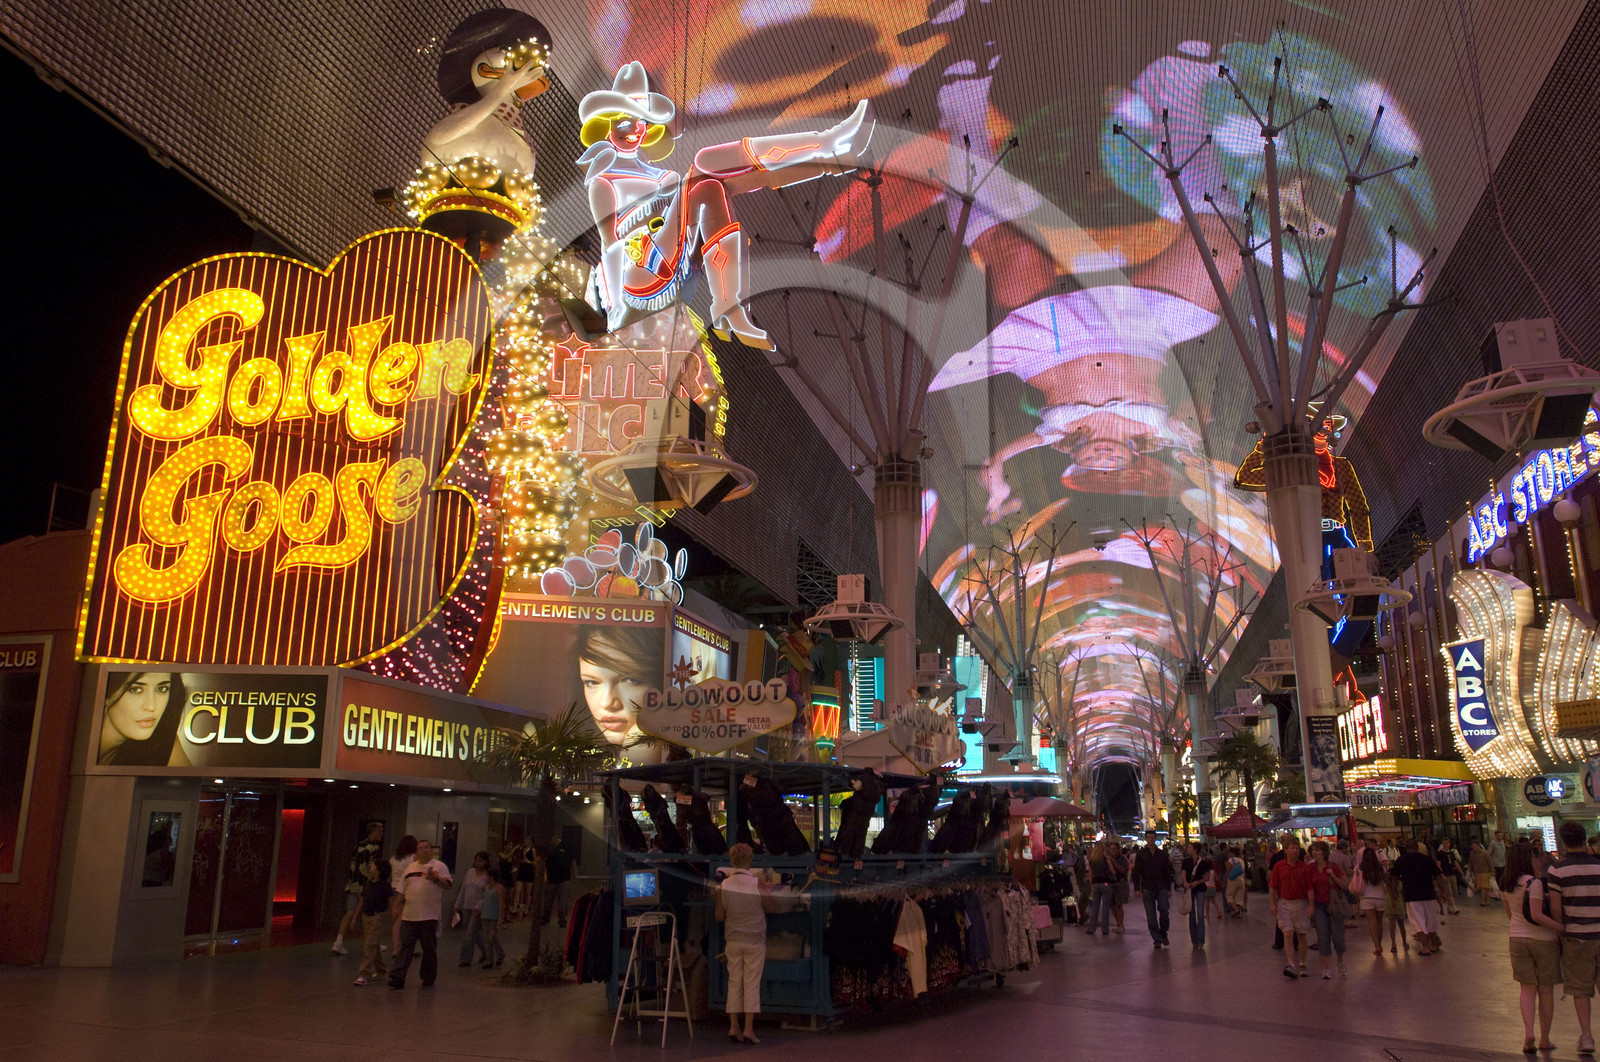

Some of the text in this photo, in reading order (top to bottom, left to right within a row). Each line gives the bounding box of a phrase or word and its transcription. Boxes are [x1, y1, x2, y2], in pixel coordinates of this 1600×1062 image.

[127, 287, 480, 442] Golden
[1468, 408, 1600, 563] ABC STORES
[114, 435, 427, 603] Goose
[498, 600, 656, 623] ENTLEMEN'S CLUB
[674, 613, 730, 652] GENTLEMEN'S CLUB
[675, 670, 690, 678] THE
[1455, 646, 1488, 725] ABC
[189, 691, 317, 707] GENTLEMEN'S
[646, 683, 783, 708] BLOWOUT
[183, 705, 317, 745] CLUB
[690, 707, 736, 724] SALE
[342, 702, 470, 761] GENTLEMEN'S
[1337, 694, 1388, 763] ONEER
[1462, 728, 1497, 736] STORES
[1526, 784, 1544, 794] AB
[1548, 780, 1563, 792] ABC
[1356, 794, 1384, 805] DOGS
